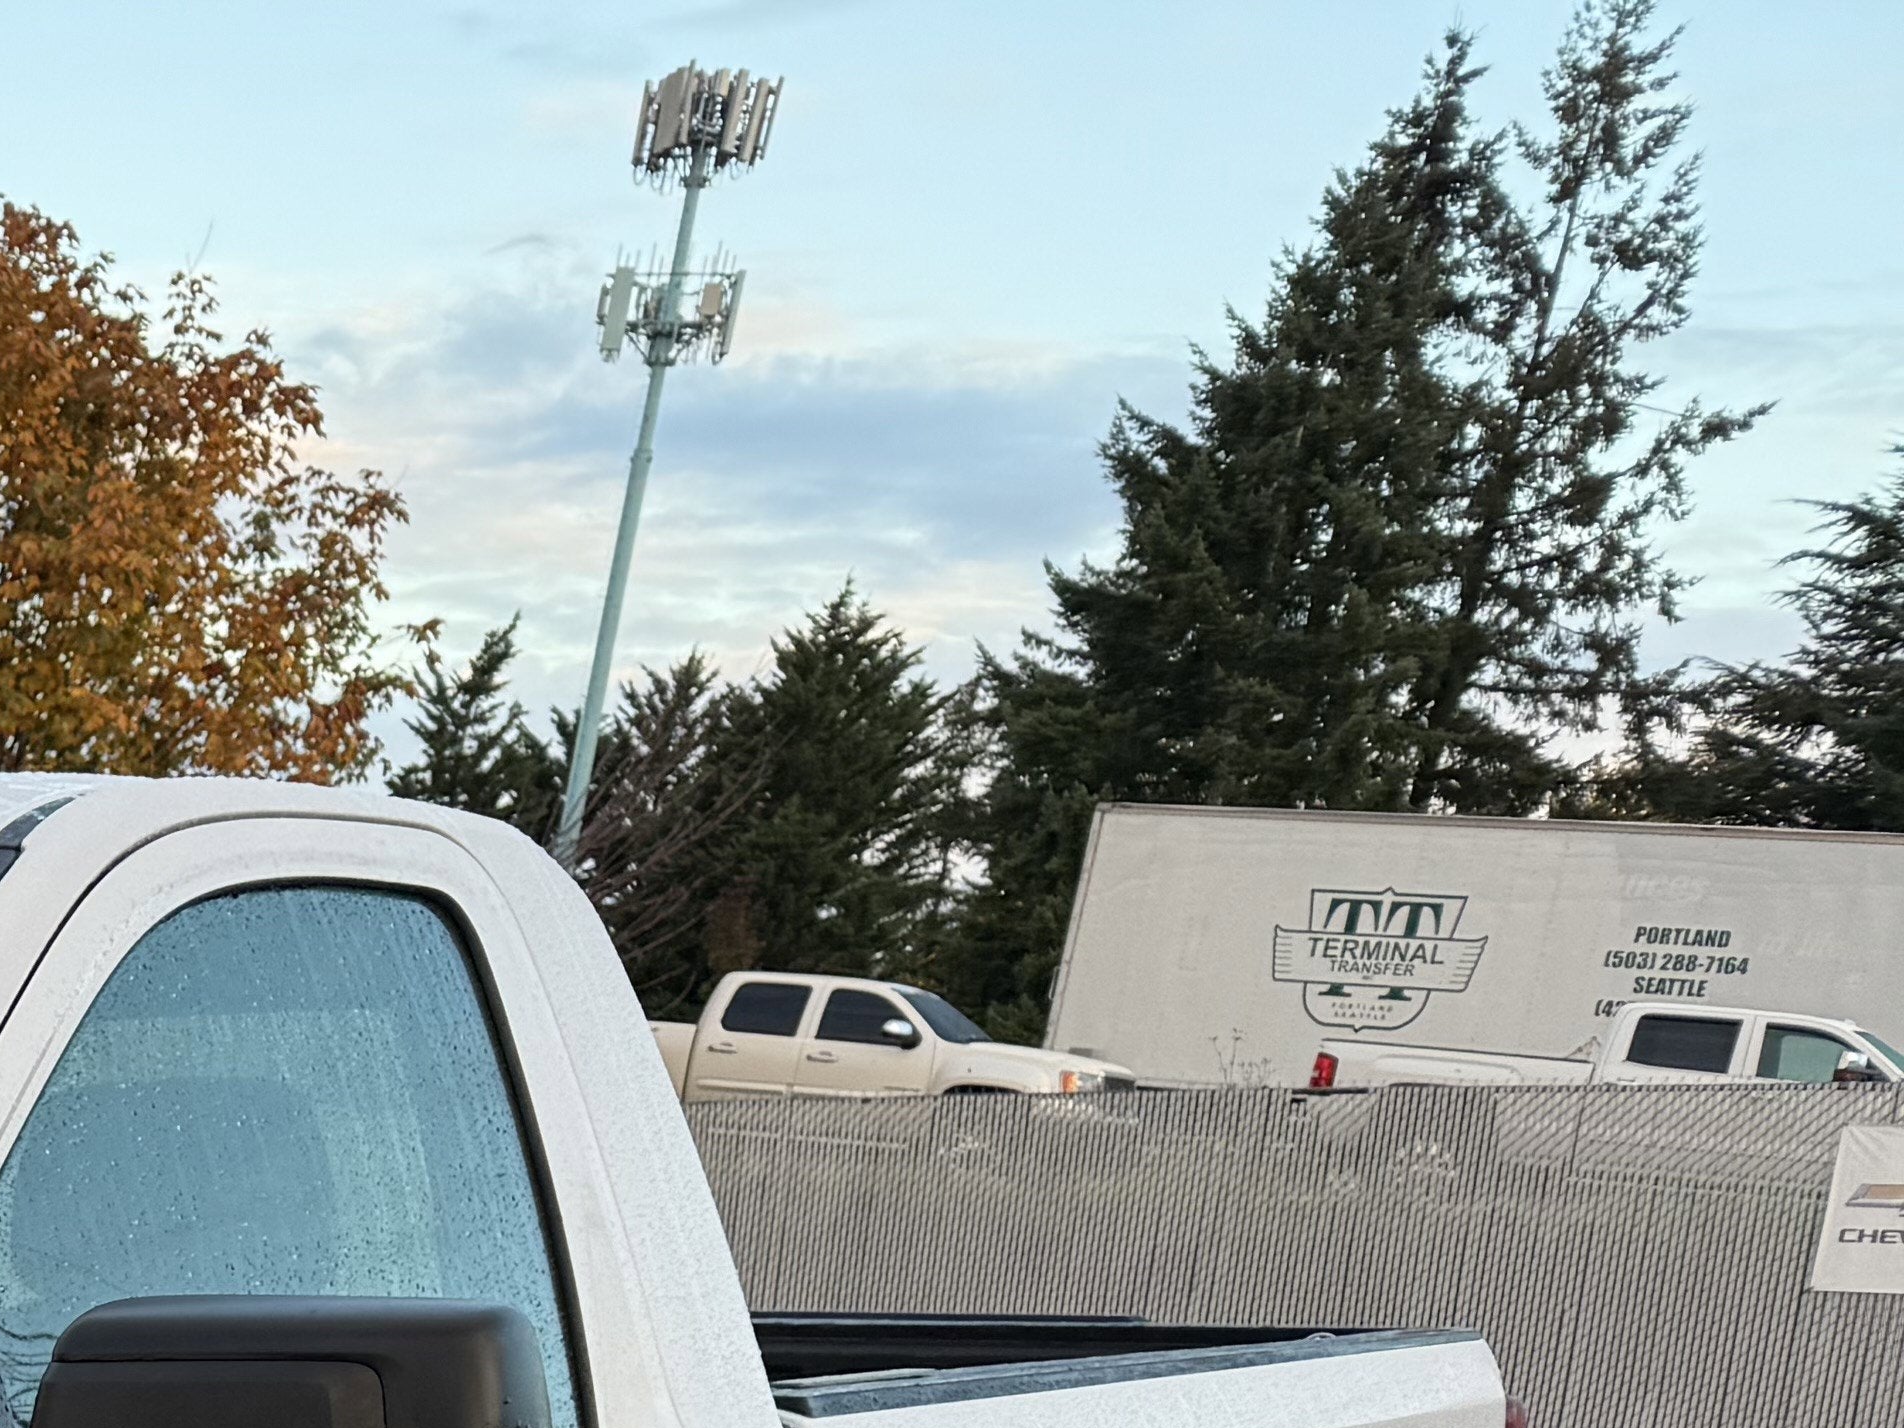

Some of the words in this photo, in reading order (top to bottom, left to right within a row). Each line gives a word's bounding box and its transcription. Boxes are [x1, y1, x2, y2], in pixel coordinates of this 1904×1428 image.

[1633, 926, 1732, 948] PORTLAND
[1308, 937, 1444, 965] TERMINAL
[1330, 960, 1415, 977] TRANSFER
[1603, 950, 1657, 970] (503)
[1659, 953, 1750, 975] 288-7164
[1633, 976, 1708, 998] SEATTLE
[1838, 1228, 1904, 1245] CHE
